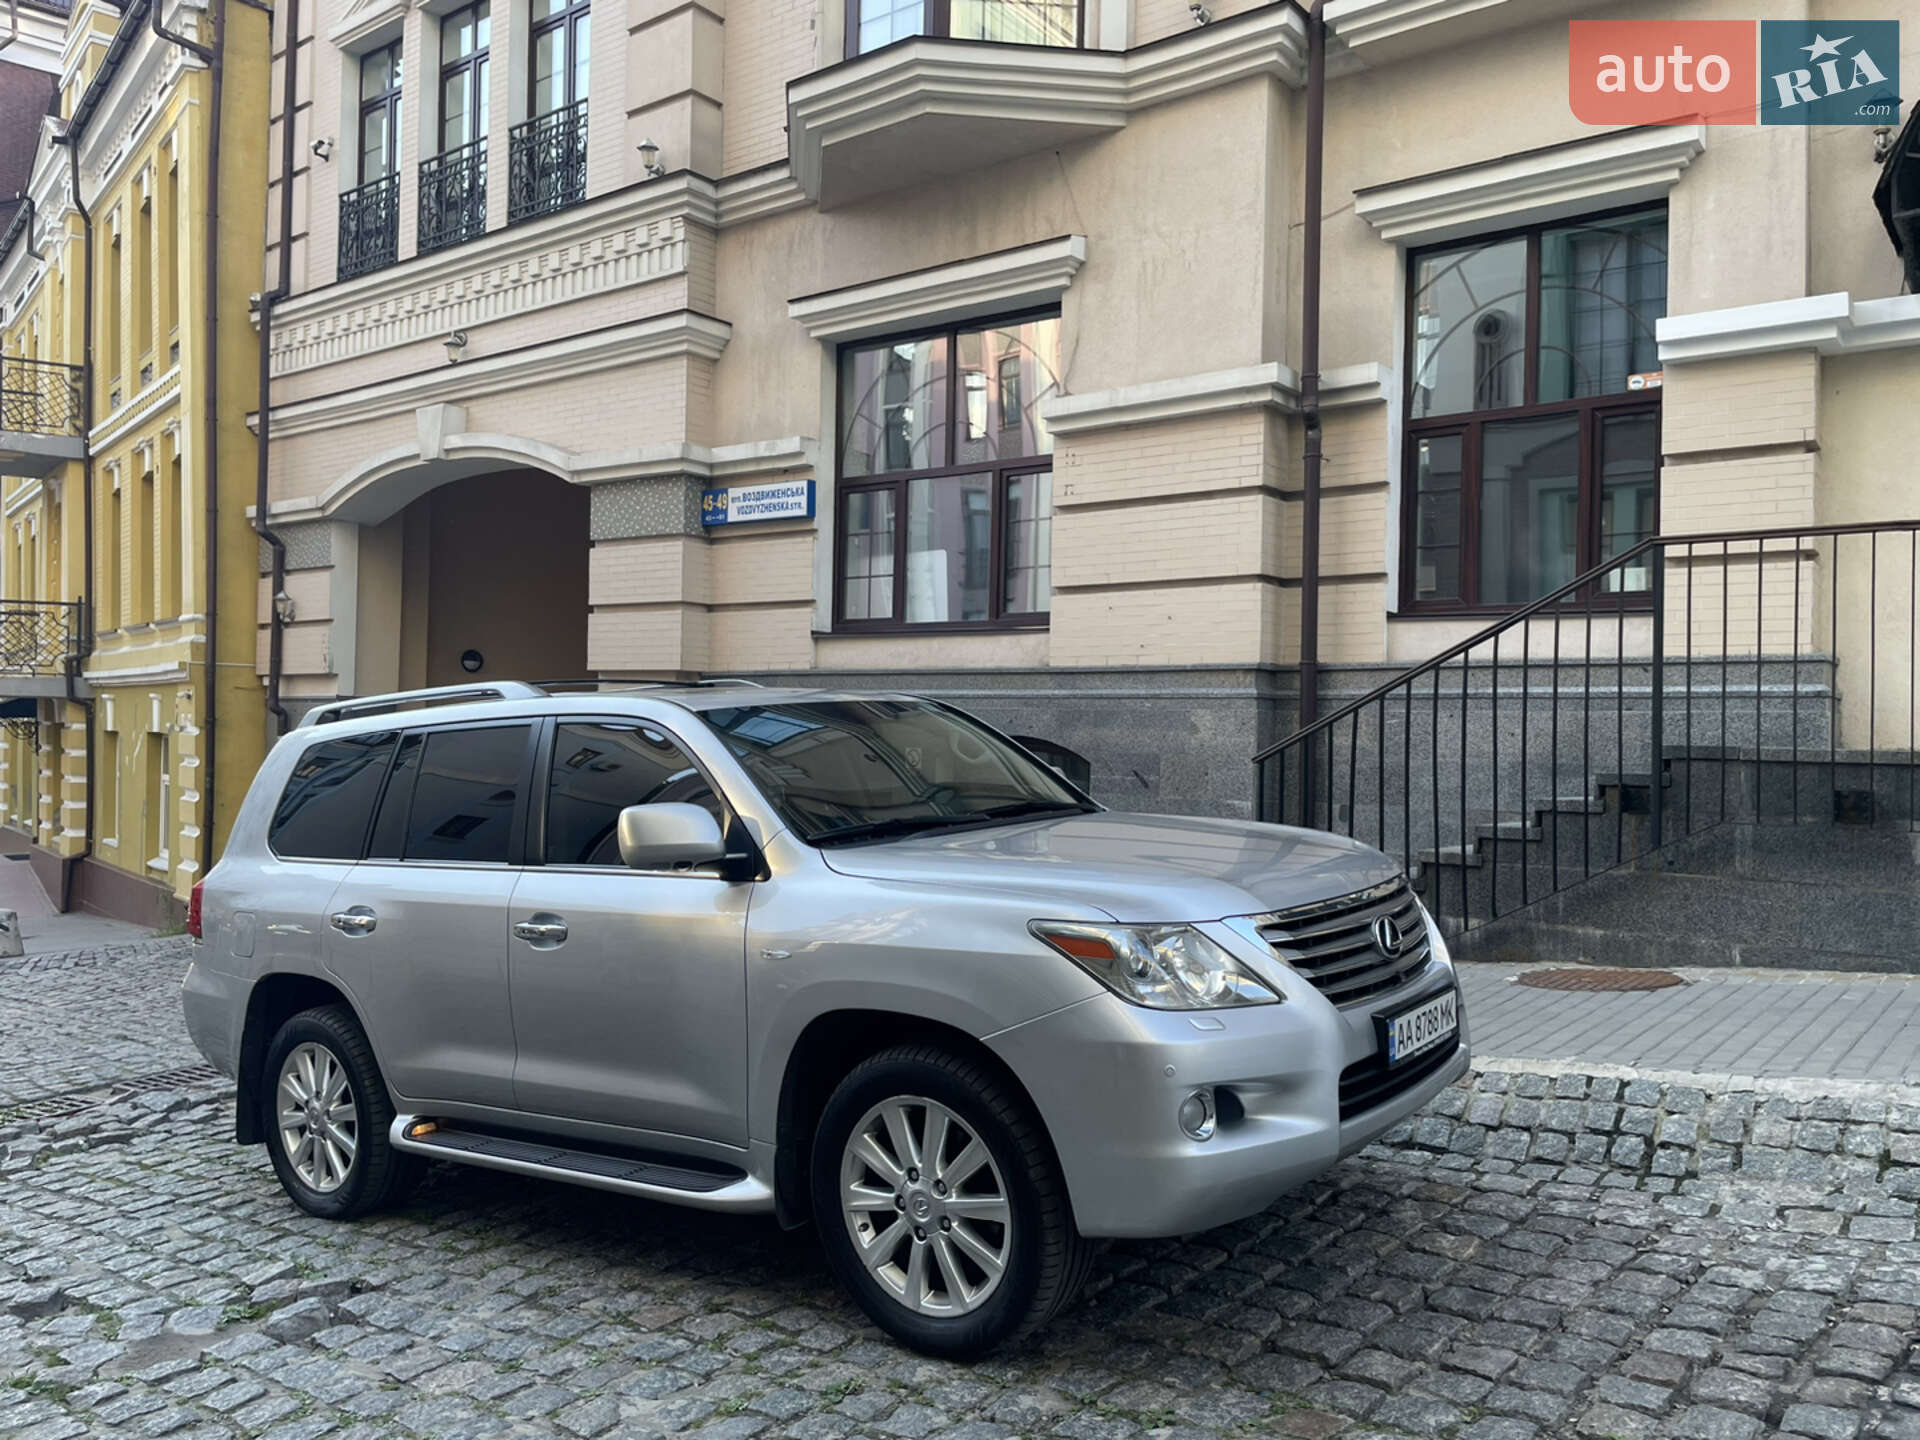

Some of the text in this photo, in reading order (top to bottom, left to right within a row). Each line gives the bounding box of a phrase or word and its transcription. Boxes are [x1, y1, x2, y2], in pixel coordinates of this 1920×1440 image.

[1397, 1019, 1414, 1054] AA
[1415, 1006, 1439, 1042] 8788
[1440, 996, 1455, 1030] MK
